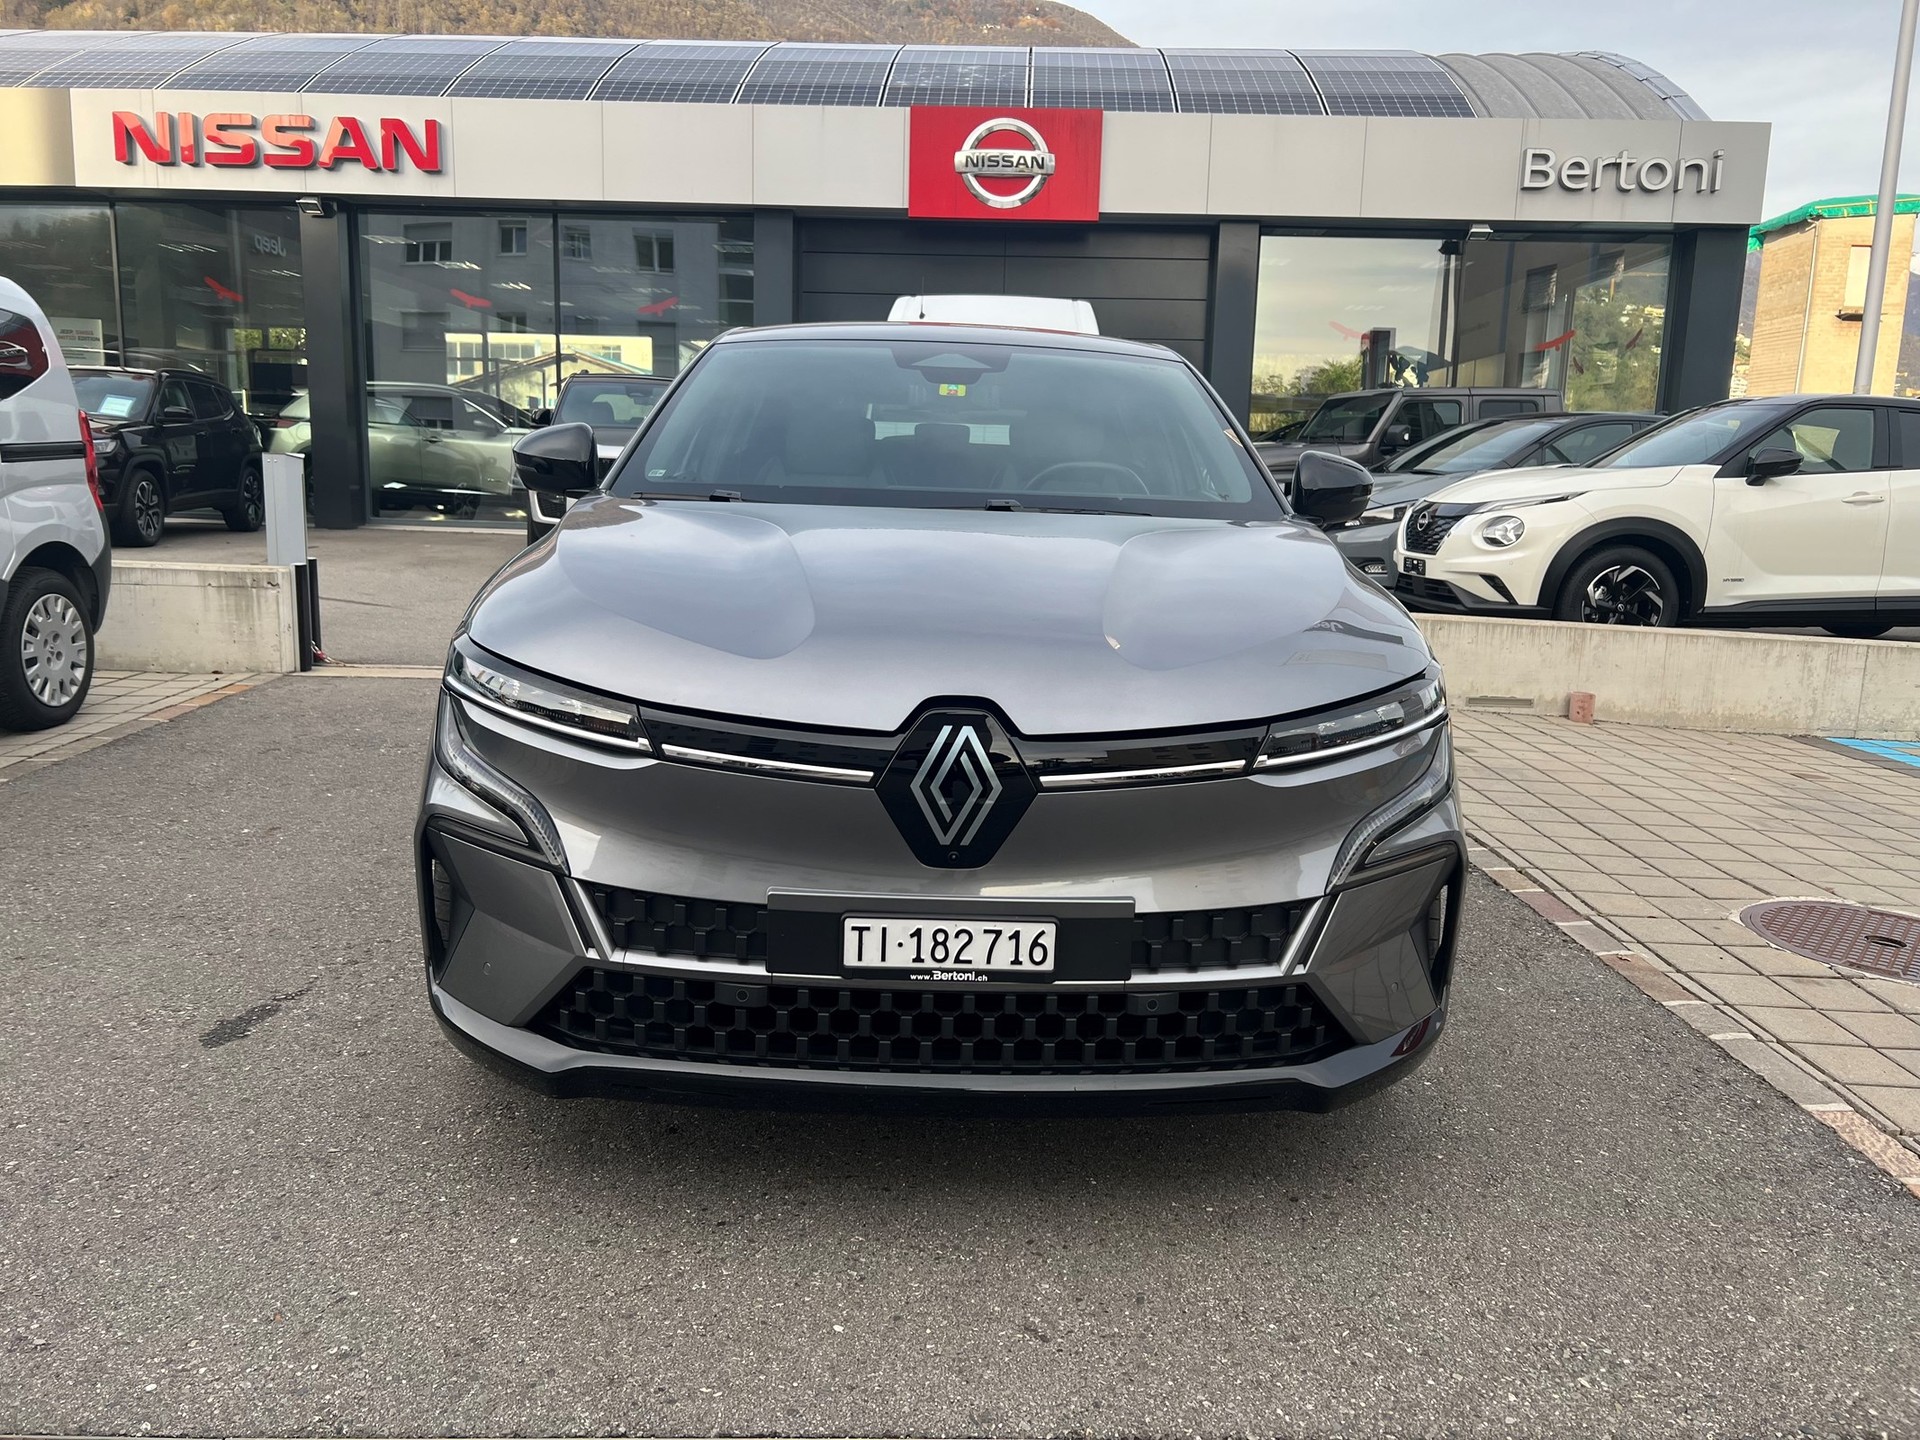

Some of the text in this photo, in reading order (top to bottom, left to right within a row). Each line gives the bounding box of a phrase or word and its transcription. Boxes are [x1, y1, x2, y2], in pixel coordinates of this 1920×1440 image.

[112, 110, 443, 172] NISSAN
[965, 154, 1046, 170] NISSAN
[1521, 148, 1725, 194] Bertoni
[910, 970, 989, 983] www.Bertoni.ch
